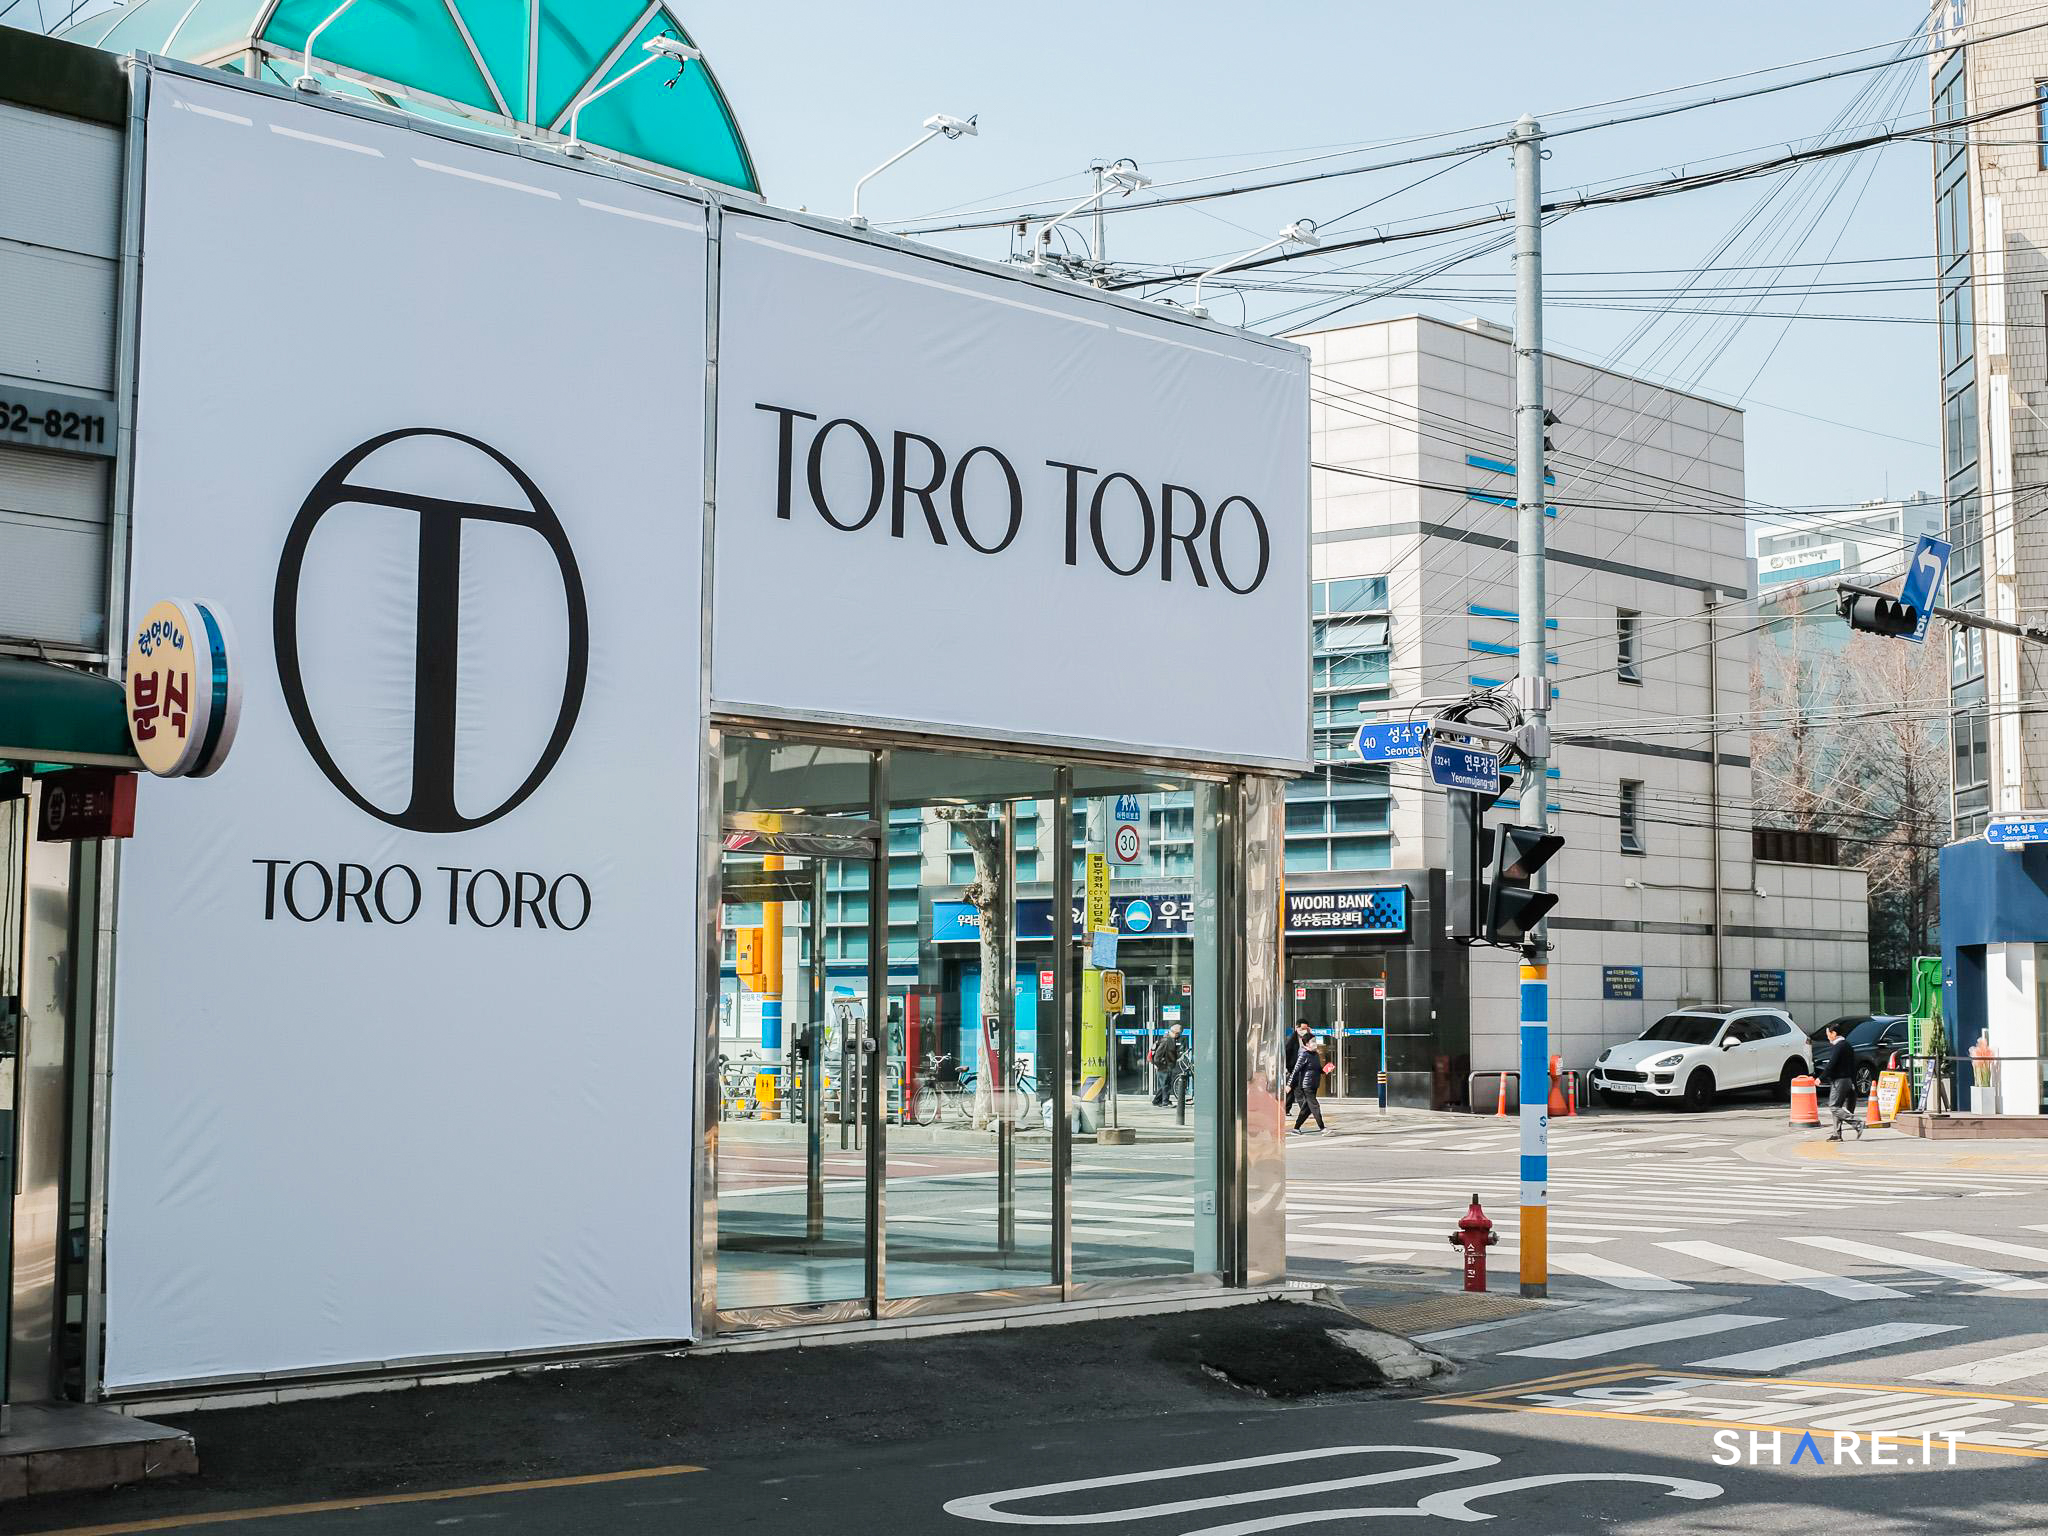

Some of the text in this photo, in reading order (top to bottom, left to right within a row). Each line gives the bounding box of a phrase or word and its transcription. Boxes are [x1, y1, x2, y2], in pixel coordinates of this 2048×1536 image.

[755, 403, 1269, 594] TORO TORO
[138, 620, 185, 658] 현영이네
[133, 669, 188, 741] 분식
[1364, 724, 1427, 749] 40 성수일
[1464, 754, 1497, 776] 연무장길
[1451, 771, 1497, 791] Yeonmujang-gil
[1120, 835, 1136, 851] 30
[253, 860, 591, 930] TORO TORO
[1290, 894, 1374, 910] WOORI BANK
[1291, 911, 1362, 927] 성수동금융센터
